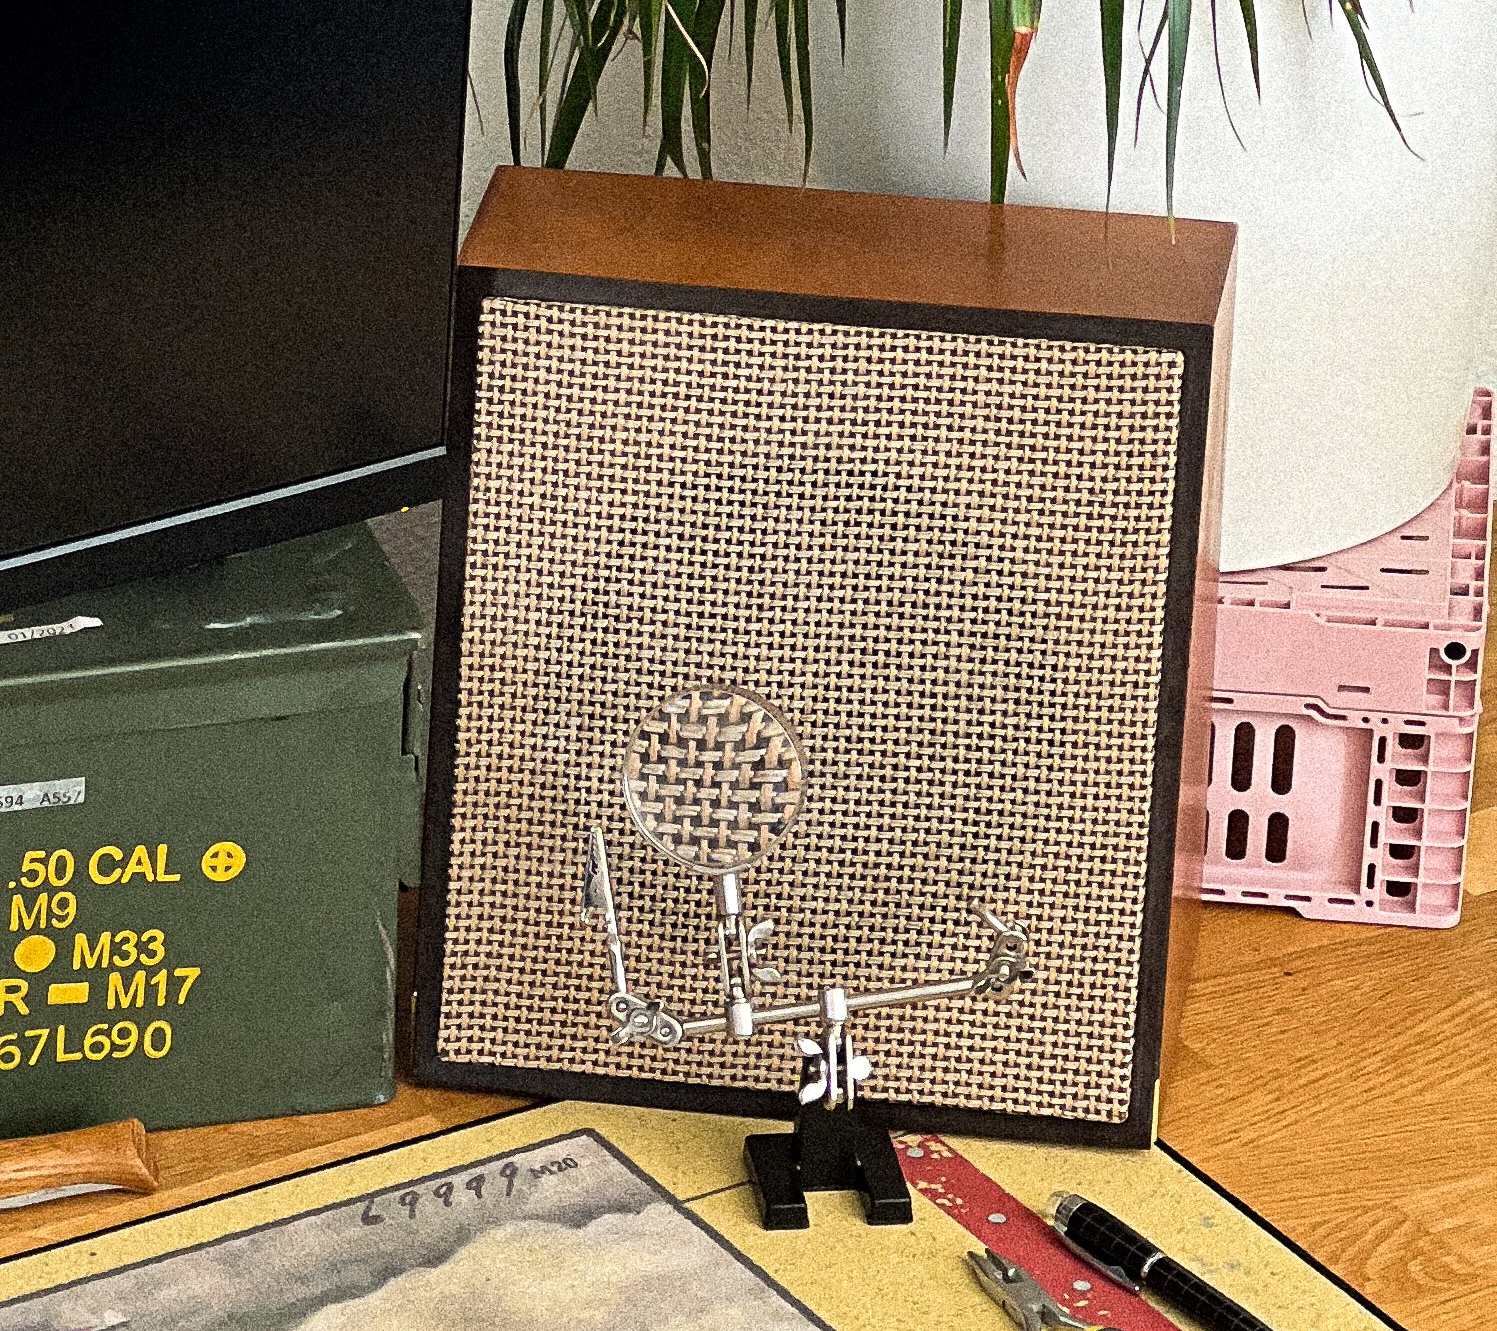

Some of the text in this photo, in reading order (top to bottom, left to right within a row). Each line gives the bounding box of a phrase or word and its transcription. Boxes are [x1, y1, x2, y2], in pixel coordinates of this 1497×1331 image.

[7, 847, 76, 890] .50
[88, 843, 181, 885] CAL
[9, 892, 77, 933] M9
[72, 928, 166, 971] M33
[106, 967, 202, 1010] M17
